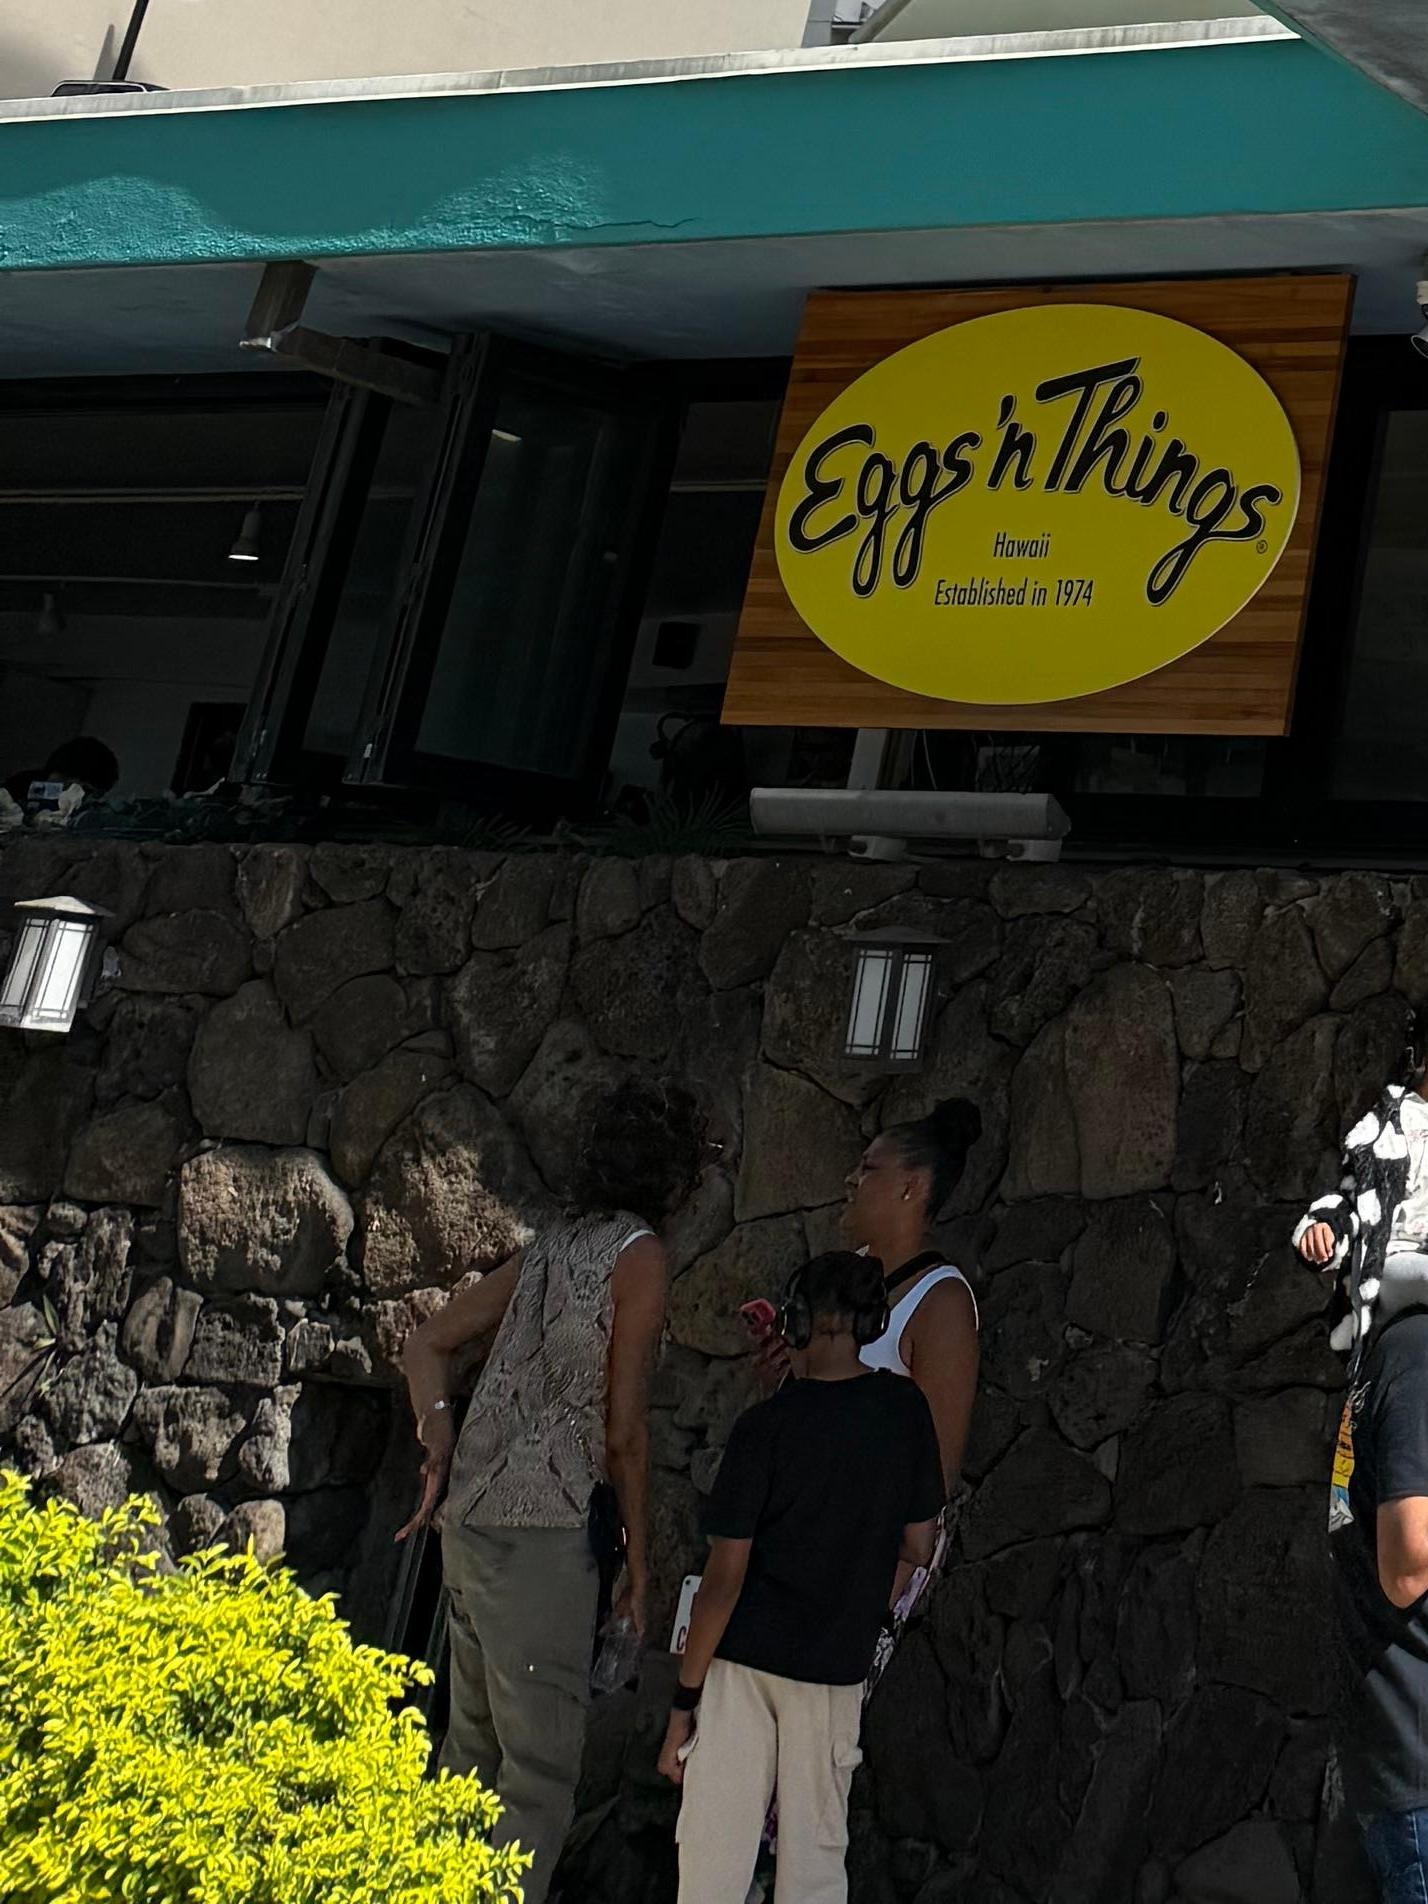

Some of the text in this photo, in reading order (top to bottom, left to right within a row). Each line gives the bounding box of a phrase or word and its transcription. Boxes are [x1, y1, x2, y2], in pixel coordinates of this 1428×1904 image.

[788, 423, 981, 598] Eggs
[1035, 356, 1282, 607] Things
[993, 532, 1051, 558] Hawaii
[934, 577, 1095, 607] Established in 1974
